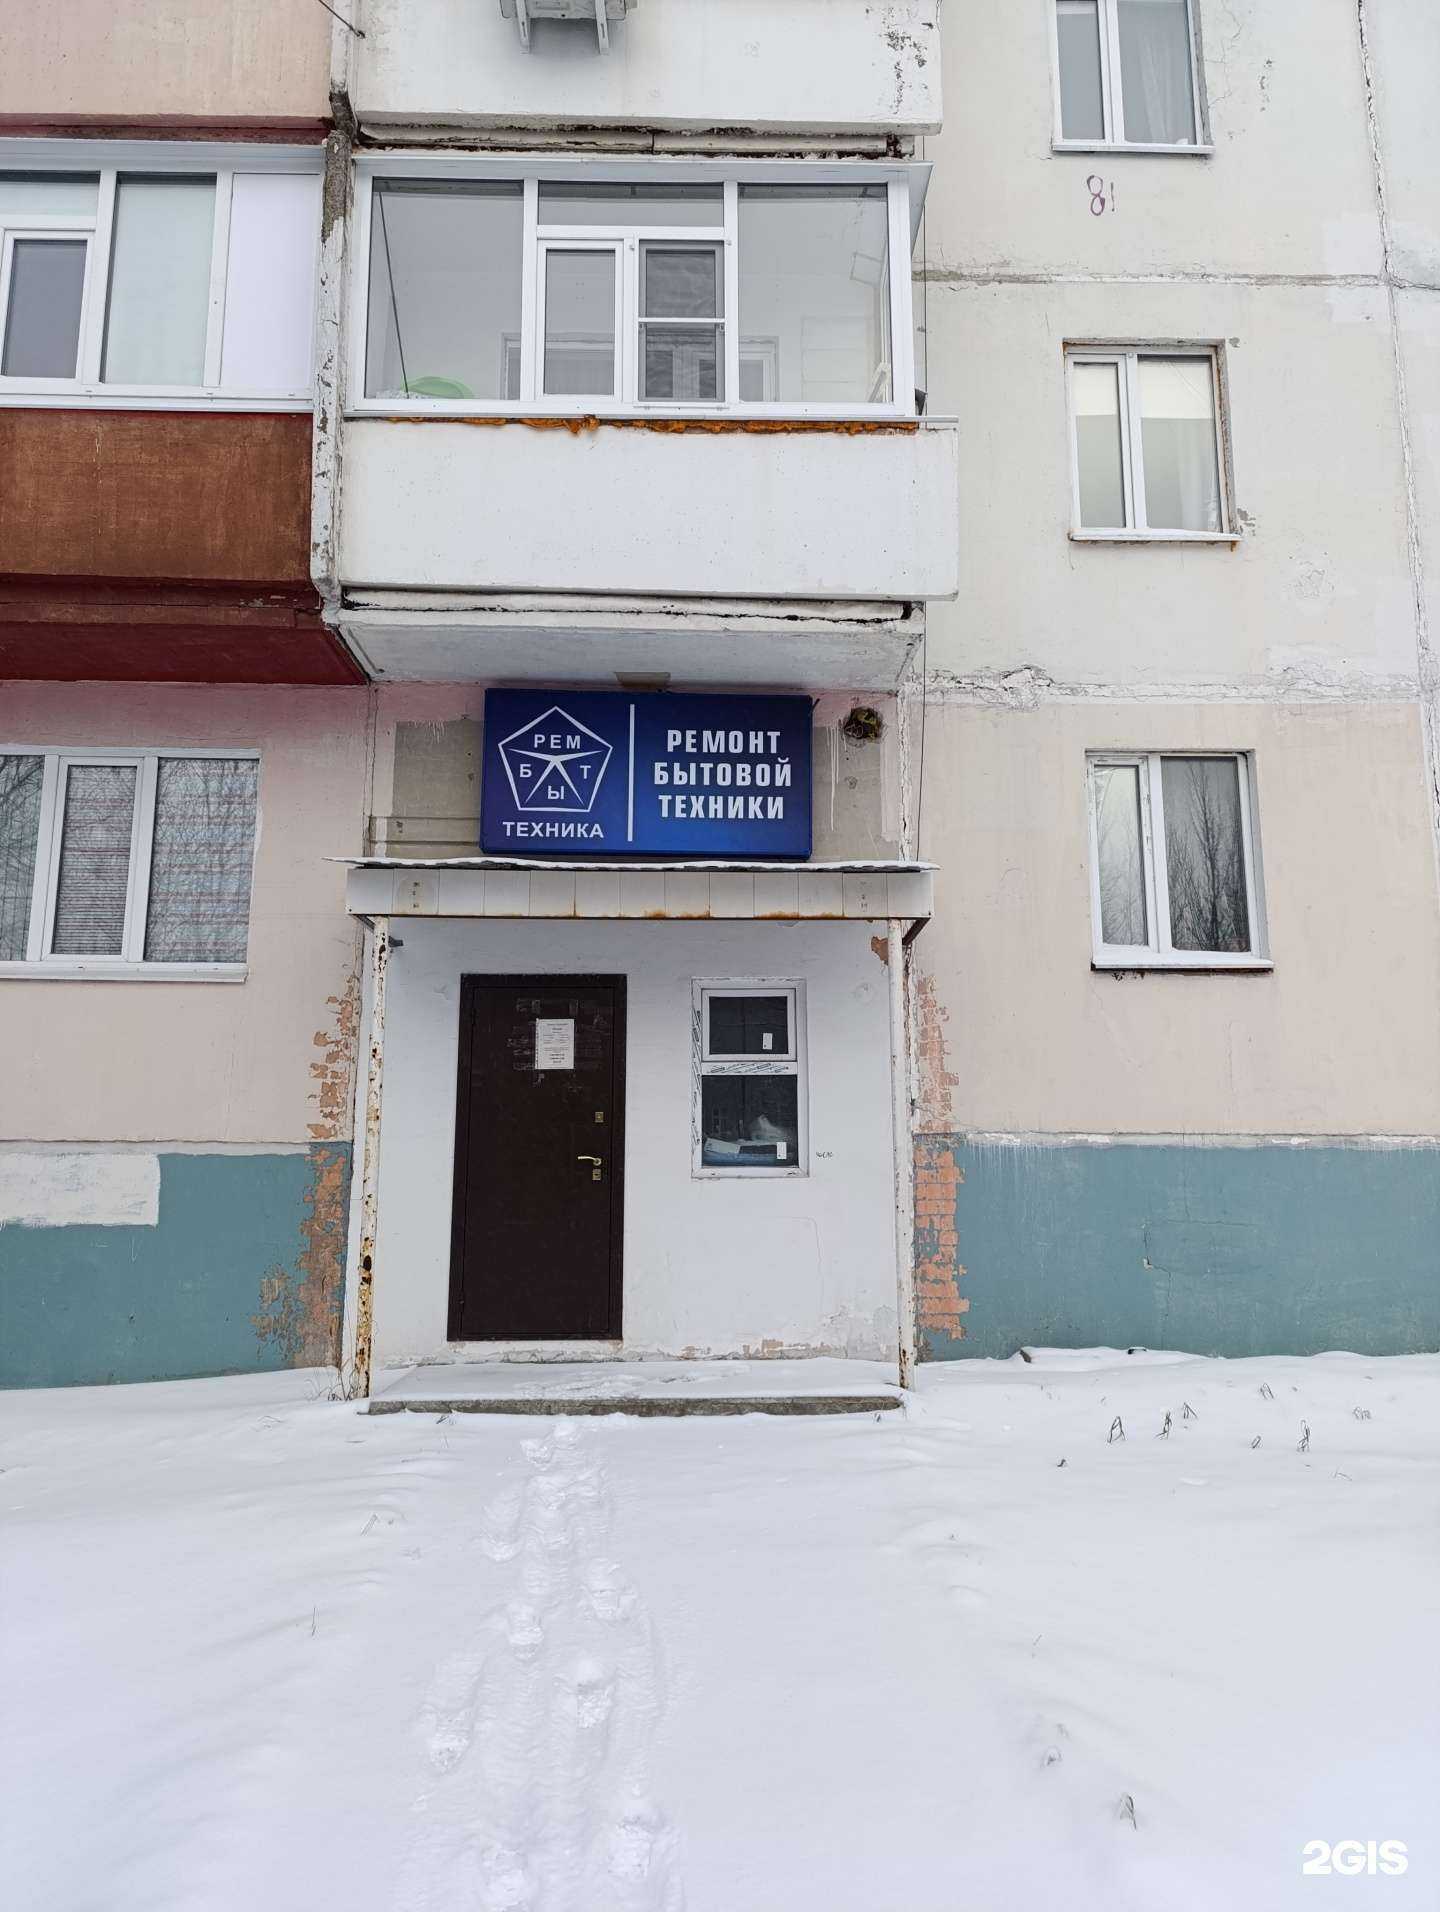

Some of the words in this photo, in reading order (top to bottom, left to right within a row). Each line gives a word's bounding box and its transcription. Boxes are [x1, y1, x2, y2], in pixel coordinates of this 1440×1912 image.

[1086, 174, 1115, 216] 81
[533, 734, 582, 750] РЕМ
[667, 729, 781, 754] РЕМОНТ
[653, 757, 792, 787] БЫТОВОЙ
[658, 794, 784, 820] ТЕХНИКИ
[502, 821, 605, 839] ТЕХНИКА
